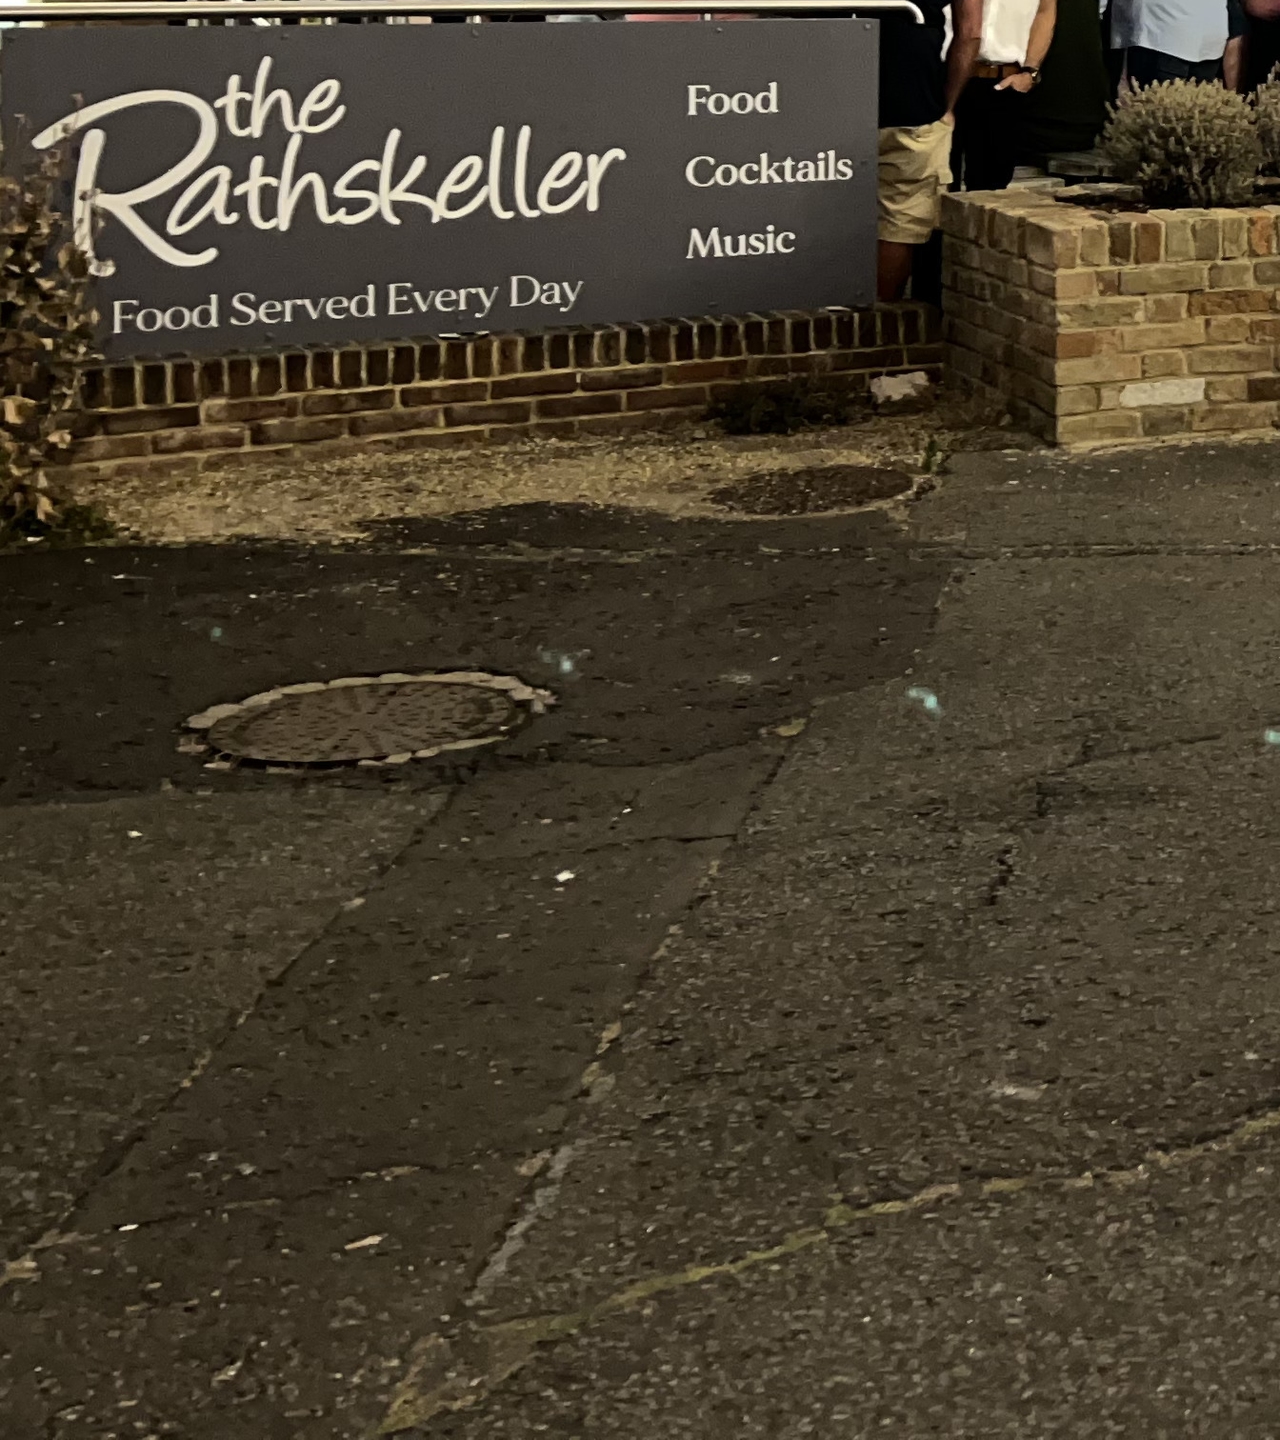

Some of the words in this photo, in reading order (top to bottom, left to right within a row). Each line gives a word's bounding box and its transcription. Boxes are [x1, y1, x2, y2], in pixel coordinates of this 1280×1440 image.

[215, 55, 347, 140] the
[686, 82, 779, 117] Food
[31, 89, 628, 277] Rathskeller
[684, 150, 854, 190] Cocktails
[685, 225, 796, 261] Music
[111, 296, 219, 335] Food
[229, 285, 377, 327] Served
[387, 279, 500, 322] Every
[509, 273, 586, 317] Day
